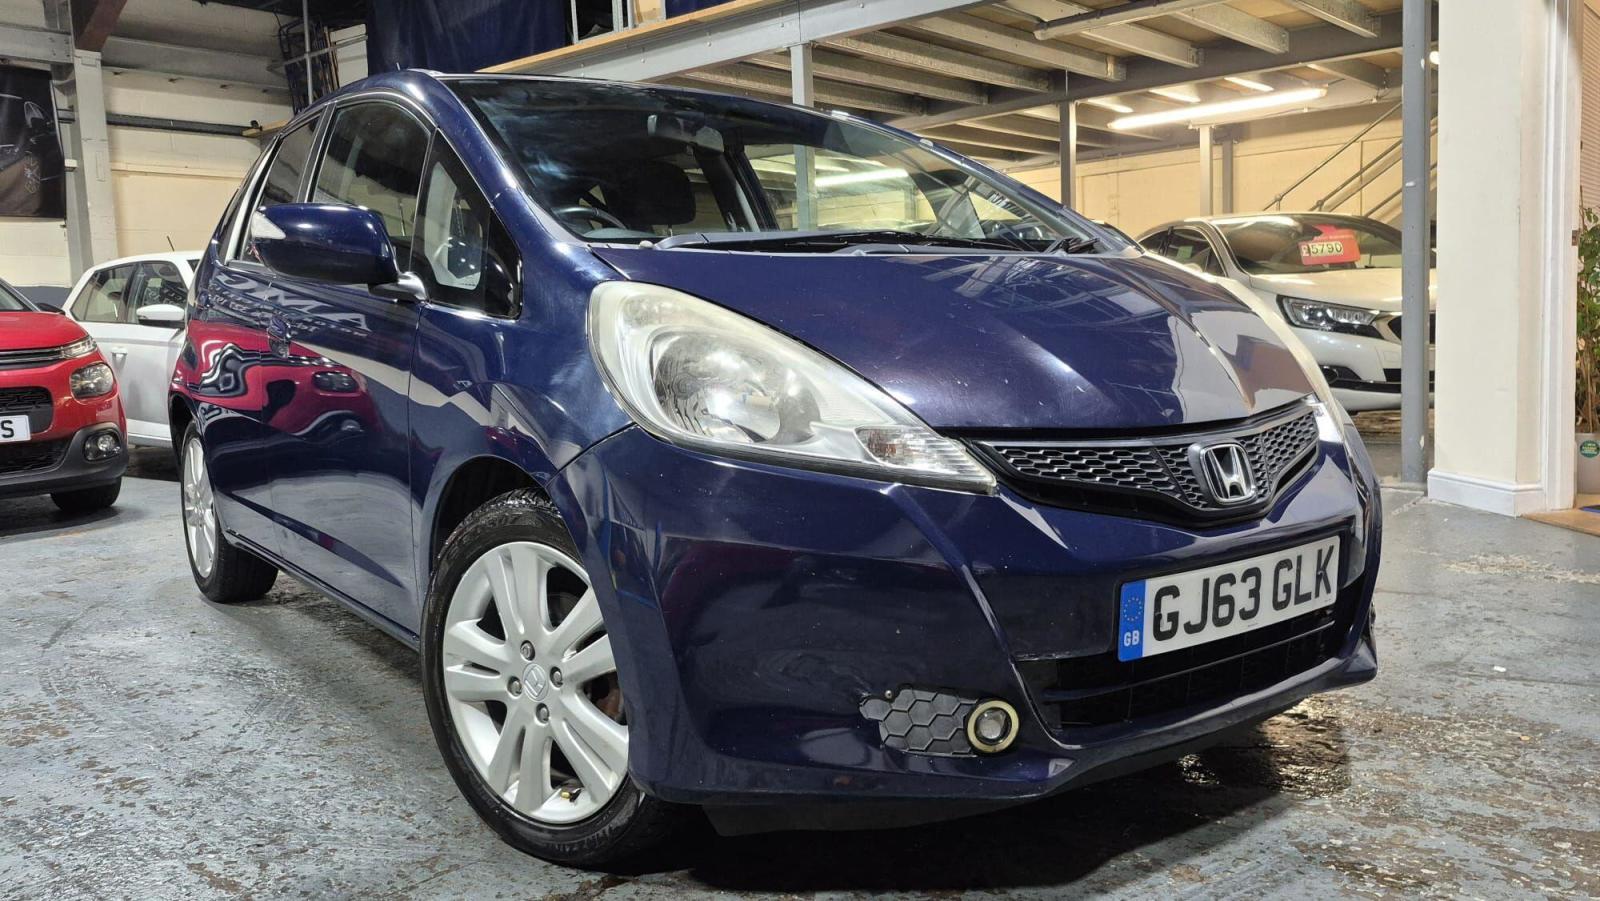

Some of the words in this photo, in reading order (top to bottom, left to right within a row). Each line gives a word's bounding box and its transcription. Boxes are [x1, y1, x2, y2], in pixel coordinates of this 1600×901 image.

[1152, 566, 1262, 642] GJ63
[1272, 545, 1335, 611] GLK
[1123, 630, 1140, 647] GB
